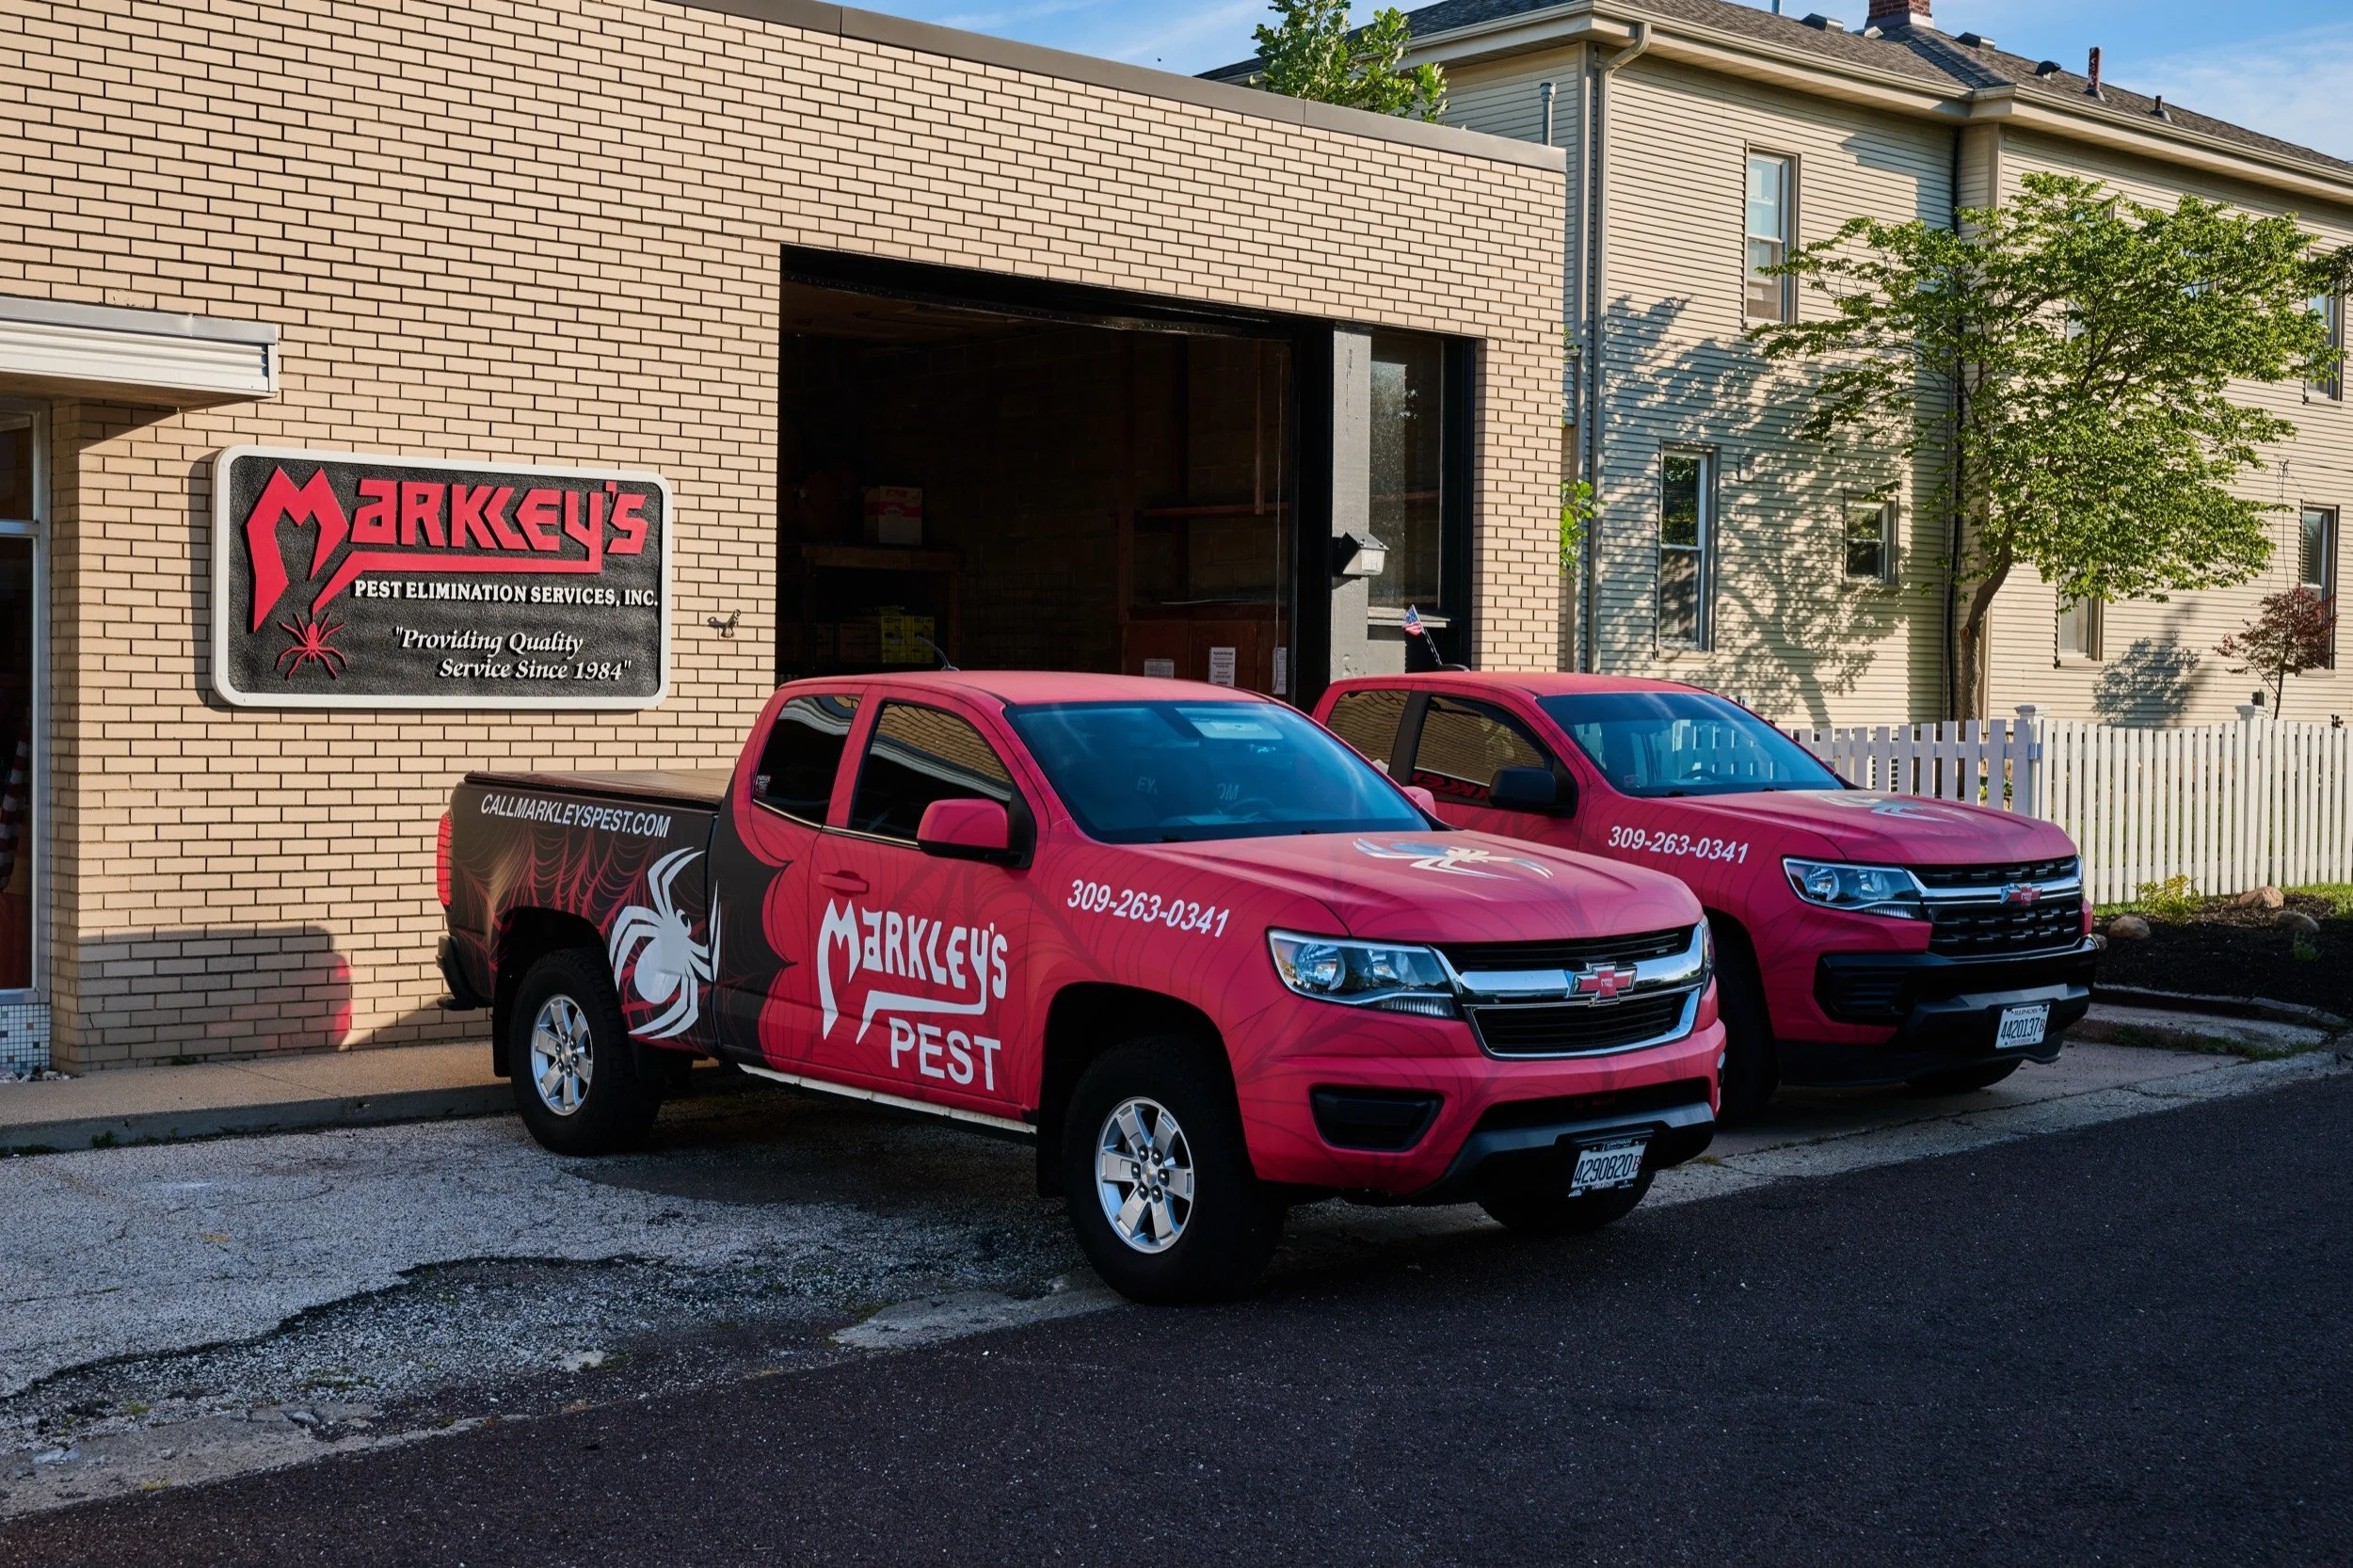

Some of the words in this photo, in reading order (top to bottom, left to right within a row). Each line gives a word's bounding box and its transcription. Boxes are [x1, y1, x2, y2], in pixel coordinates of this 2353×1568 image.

[354, 579, 403, 599] PEST
[406, 581, 526, 603] ELIMINATION
[530, 586, 621, 607] SERVICES,
[624, 589, 659, 607] INC.
[394, 626, 503, 658] "Providing
[508, 630, 584, 659] Quality
[439, 658, 512, 679] Service
[516, 660, 568, 680] Since
[573, 659, 632, 680] 1984"
[480, 793, 672, 838] CALLMARKLEYSPEST.COM
[1608, 825, 1749, 864] 309-263-0341
[1066, 879, 1230, 938] 309-263-0341
[888, 1016, 1001, 1092] PEST
